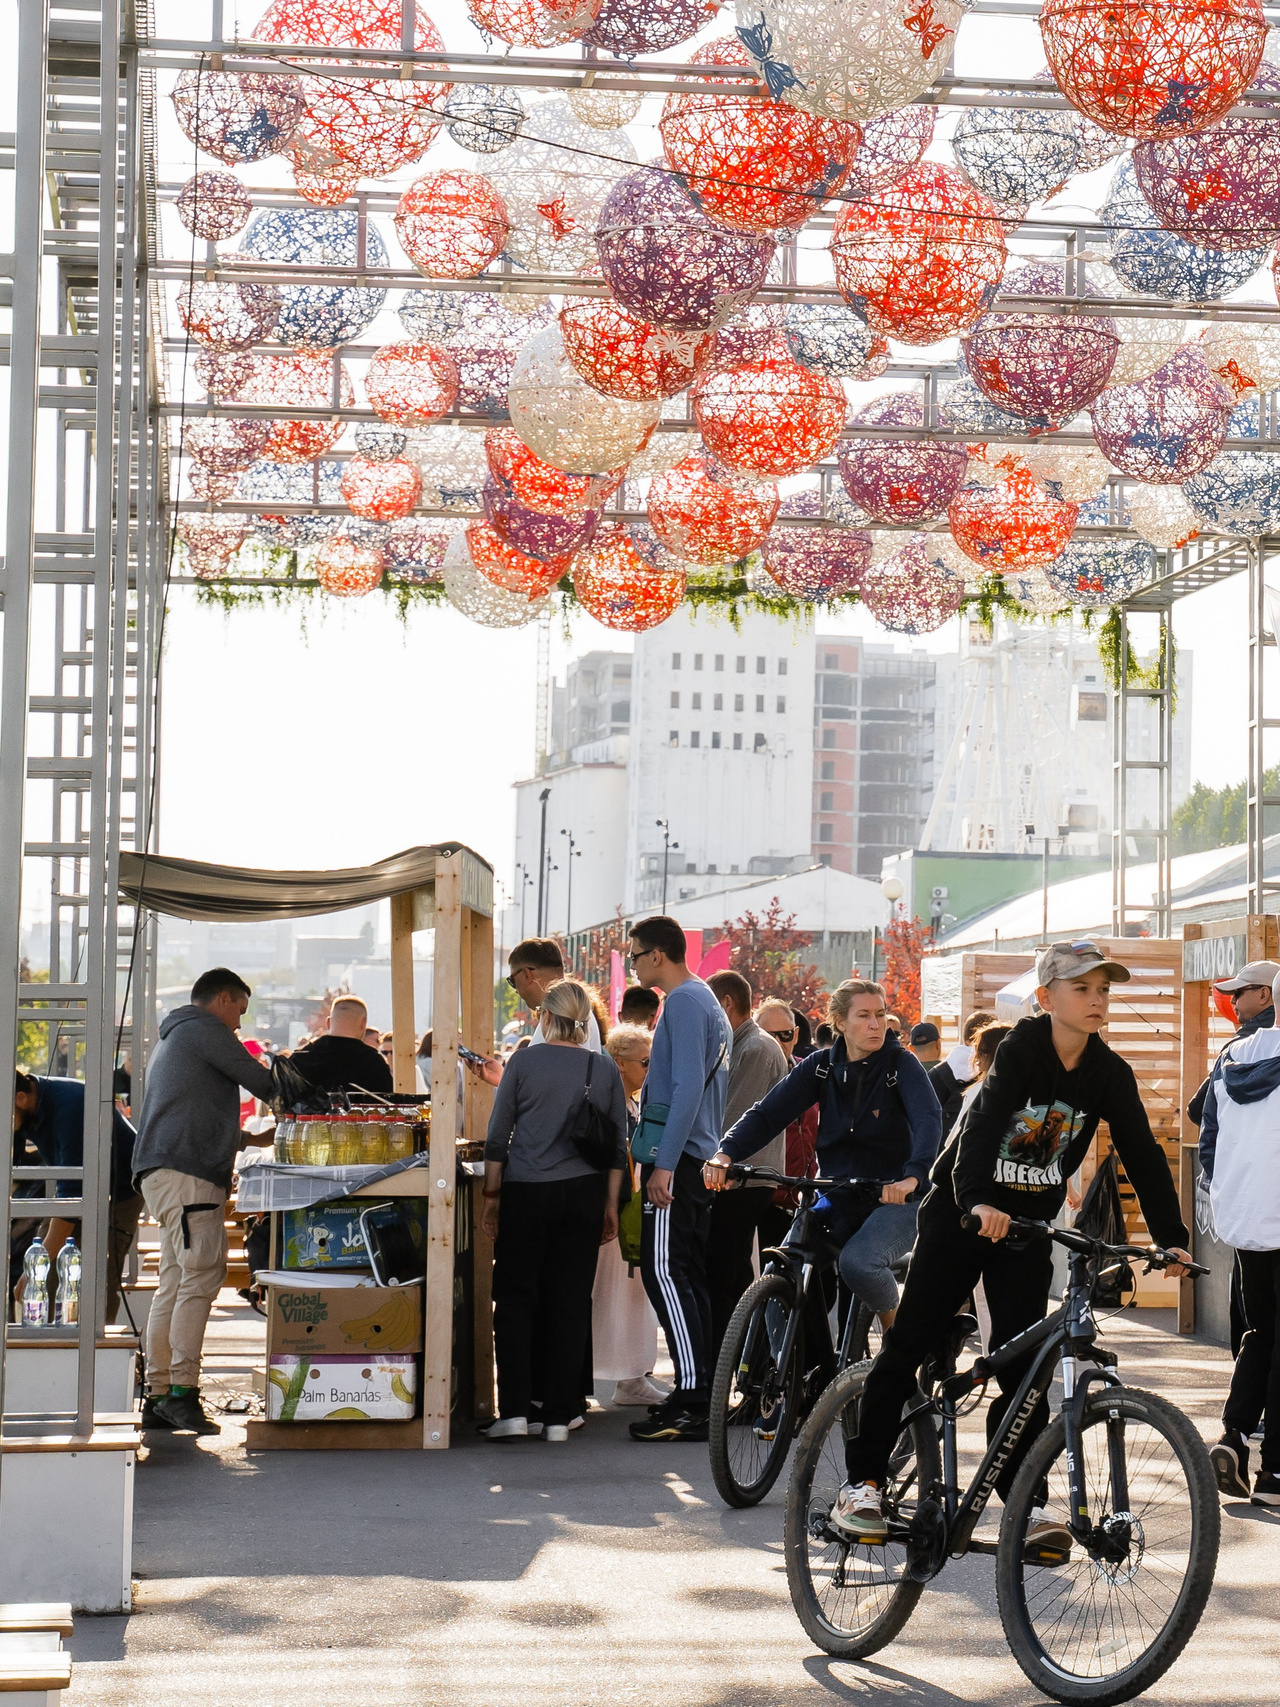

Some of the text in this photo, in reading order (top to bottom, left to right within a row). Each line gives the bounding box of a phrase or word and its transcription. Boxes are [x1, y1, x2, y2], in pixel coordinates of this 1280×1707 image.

[993, 1158, 1062, 1185] IBERIA
[324, 1206, 357, 1214] Premium
[278, 1292, 321, 1307] Global
[298, 1388, 381, 1403] Palm Bananas
[970, 1388, 1041, 1513] RUSH HOUR
